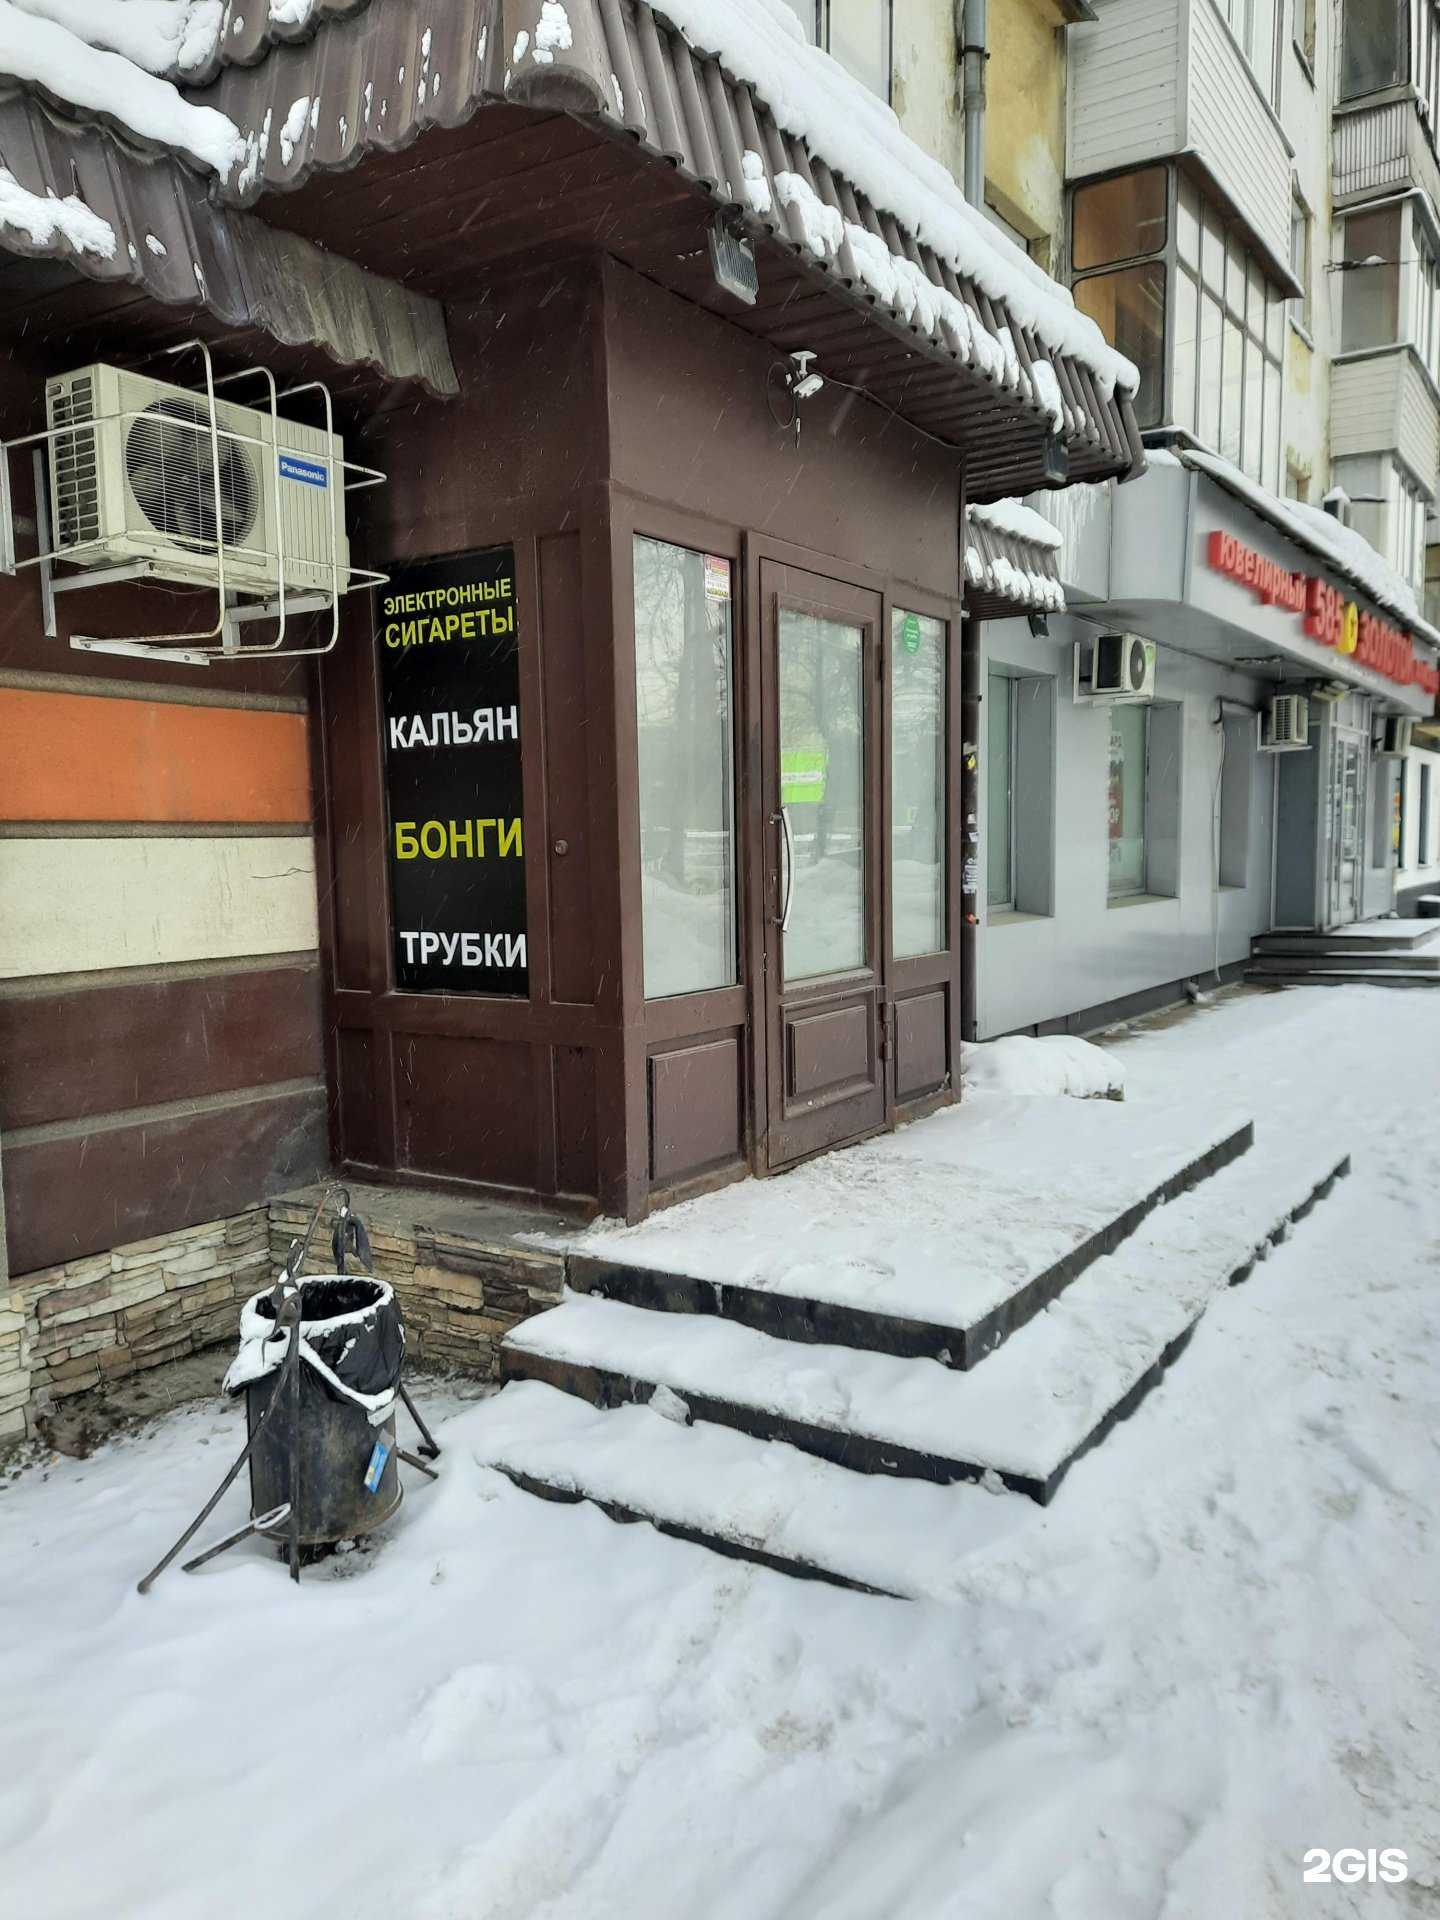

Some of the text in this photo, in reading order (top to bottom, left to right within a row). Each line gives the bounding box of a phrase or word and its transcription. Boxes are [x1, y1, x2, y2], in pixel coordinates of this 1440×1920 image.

[281, 461, 325, 481] Panasonic
[384, 578, 512, 615] ЭЛЕКТРОННЫЕ
[1306, 577, 1344, 647] 585
[385, 606, 513, 648] СИГАРЕТЫ
[389, 705, 518, 749] КАЛЬЯН
[395, 818, 523, 860] БОНГИ
[400, 931, 527, 968] ТРУБКИ
